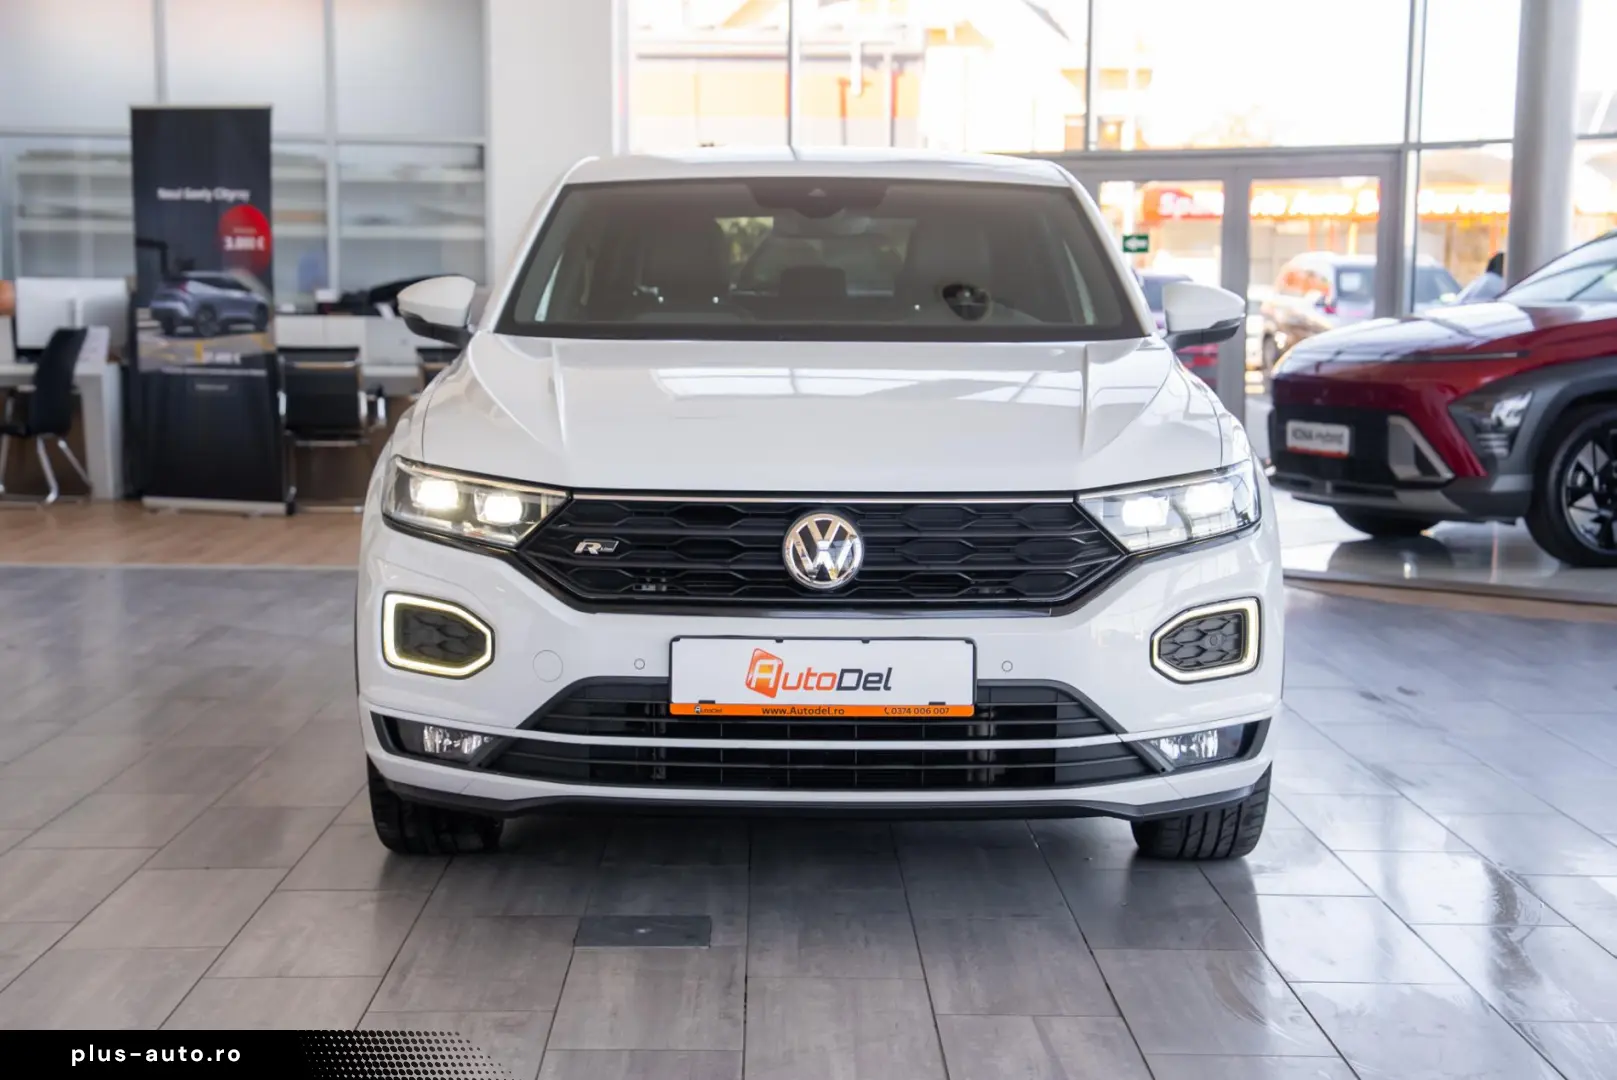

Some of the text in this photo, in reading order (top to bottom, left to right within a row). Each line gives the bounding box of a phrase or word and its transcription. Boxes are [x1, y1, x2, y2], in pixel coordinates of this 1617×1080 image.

[747, 654, 893, 694] AutoDel
[762, 706, 845, 716] www.Autodel.ro
[891, 707, 950, 715] 0374 006 007
